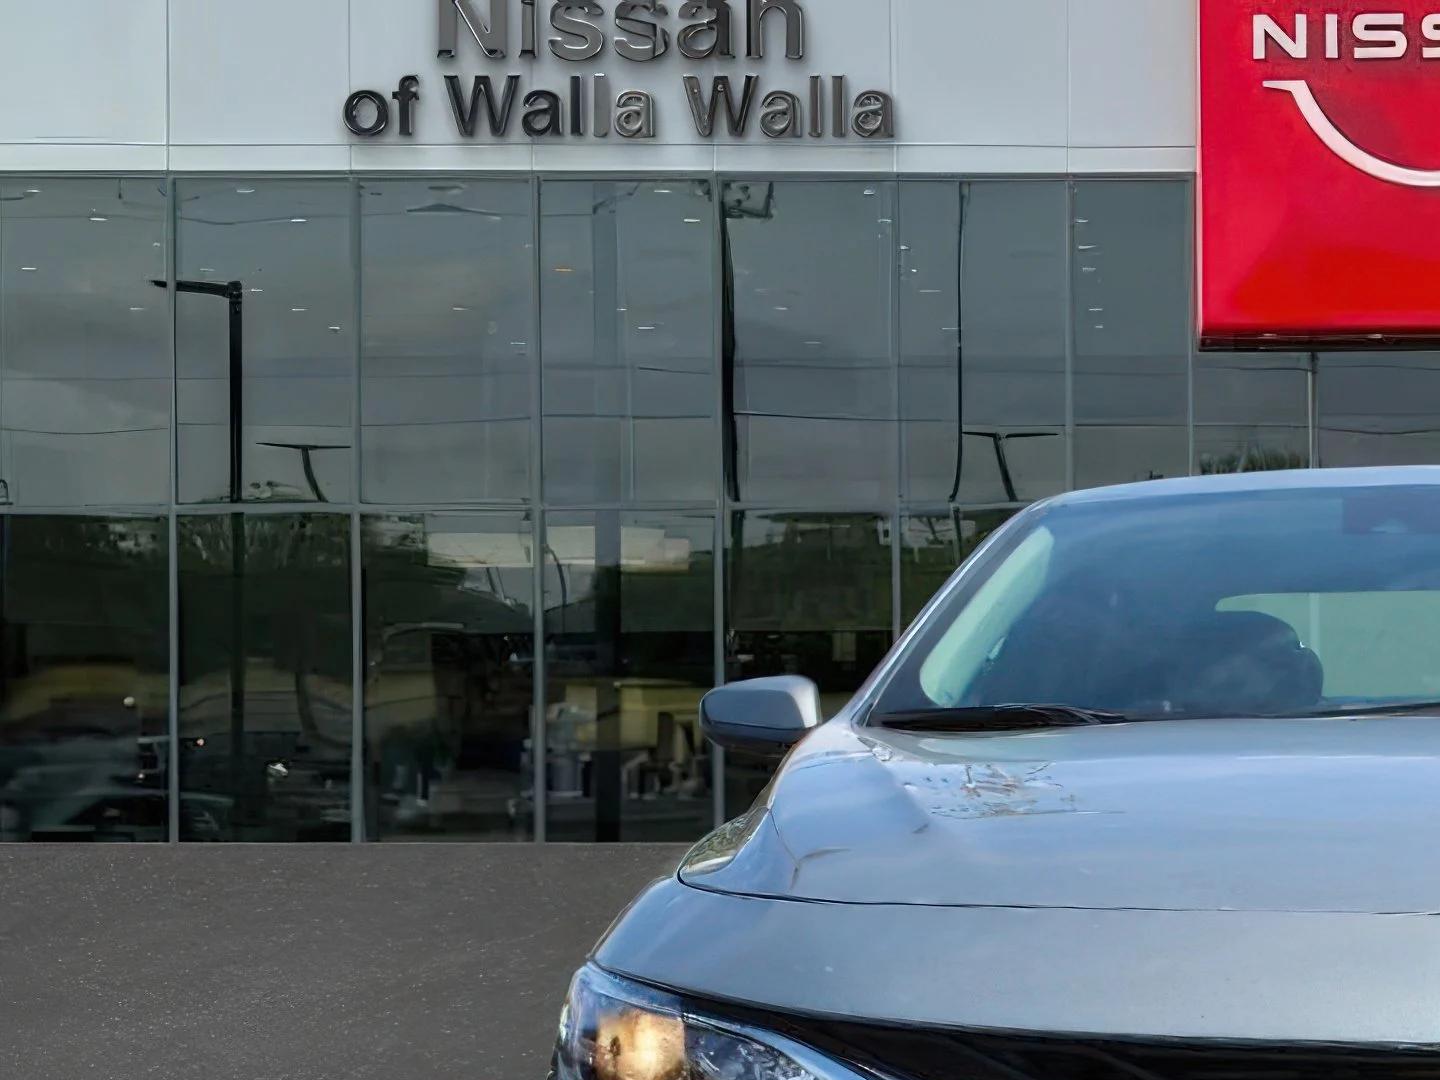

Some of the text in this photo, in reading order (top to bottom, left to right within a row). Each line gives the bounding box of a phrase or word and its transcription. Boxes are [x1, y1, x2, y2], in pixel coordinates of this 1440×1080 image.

[341, 74, 897, 138] of Walla Walla
